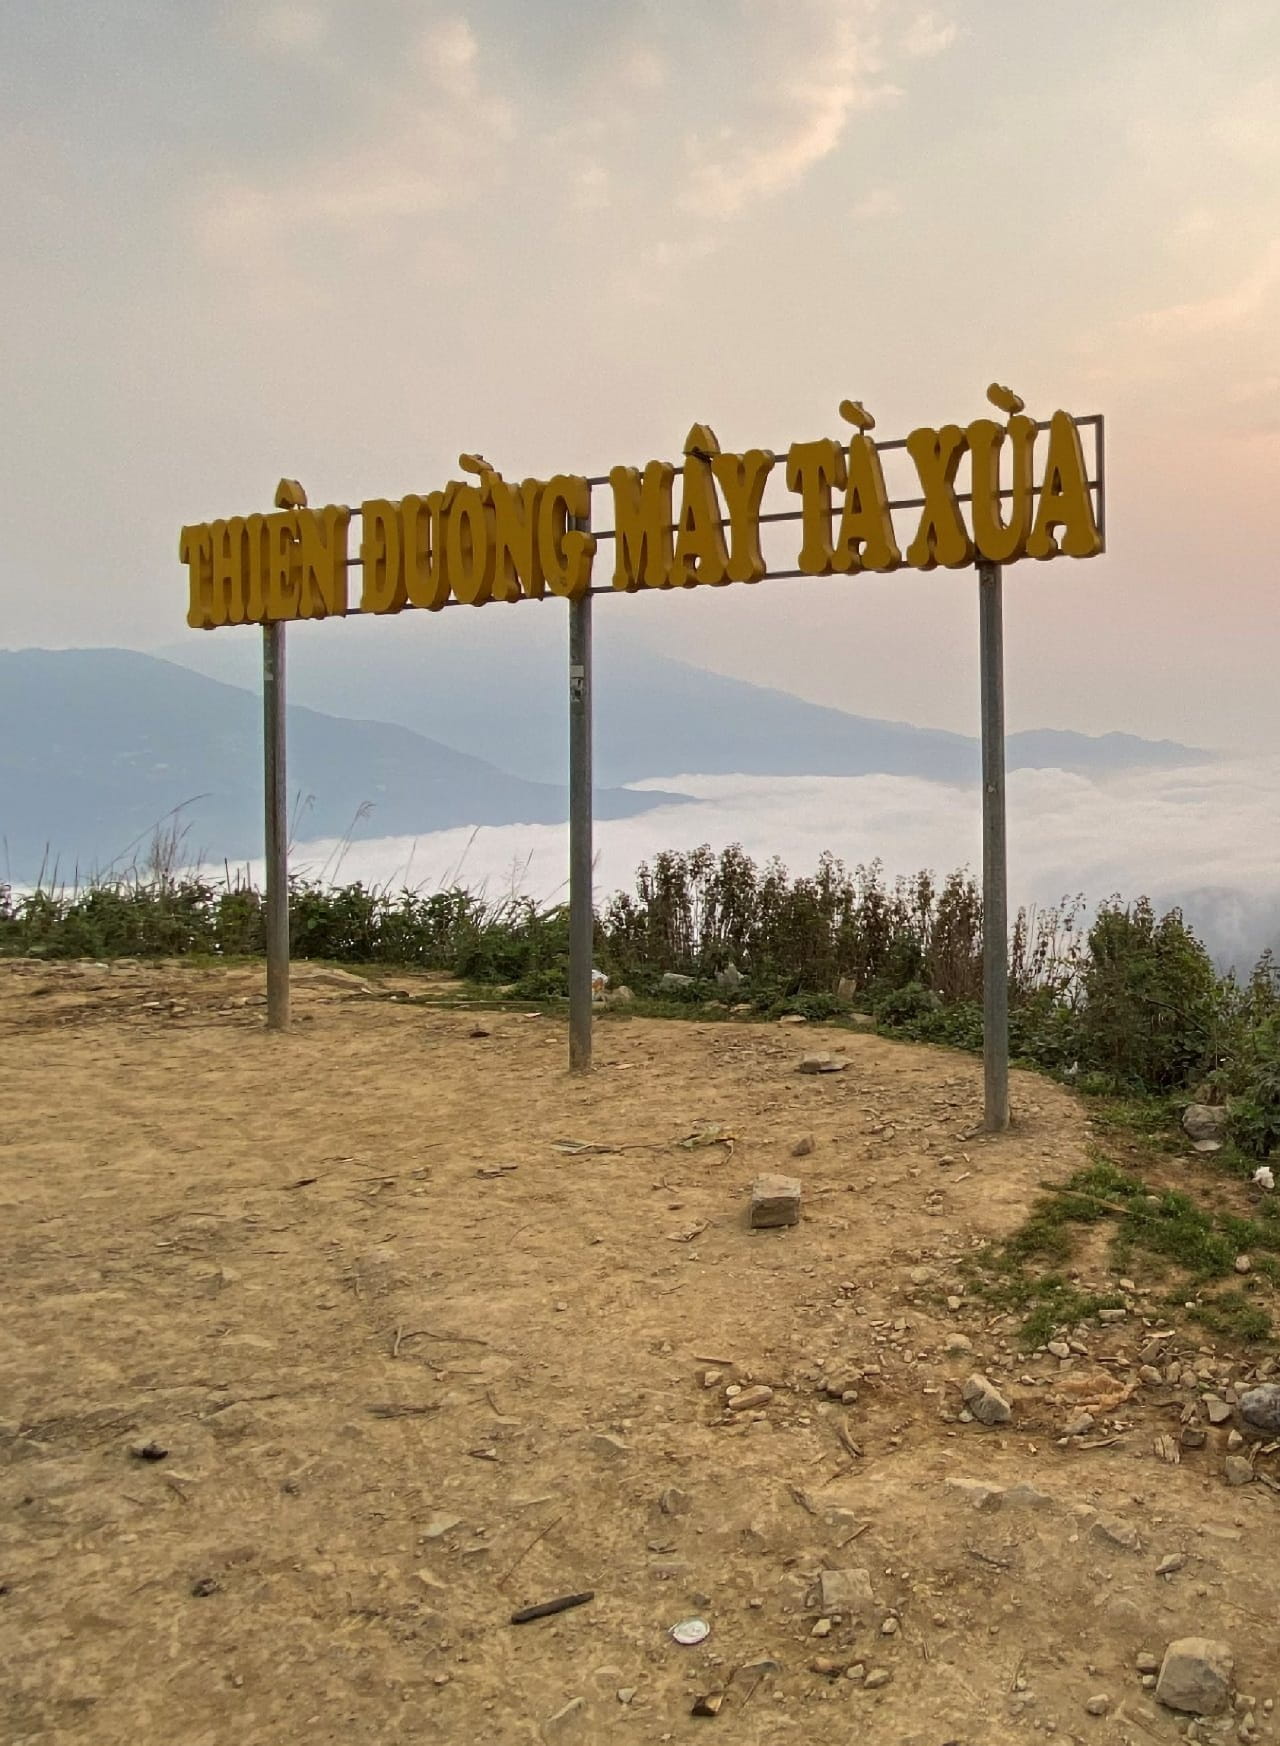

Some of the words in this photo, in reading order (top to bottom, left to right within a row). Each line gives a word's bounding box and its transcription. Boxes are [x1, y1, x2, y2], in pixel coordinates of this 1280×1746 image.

[180, 478, 350, 629] THIÊN
[360, 454, 597, 615] ĐƯỜNG
[609, 422, 775, 592] MÂY
[786, 400, 900, 575] TÀ
[907, 383, 1101, 571] XÙA
